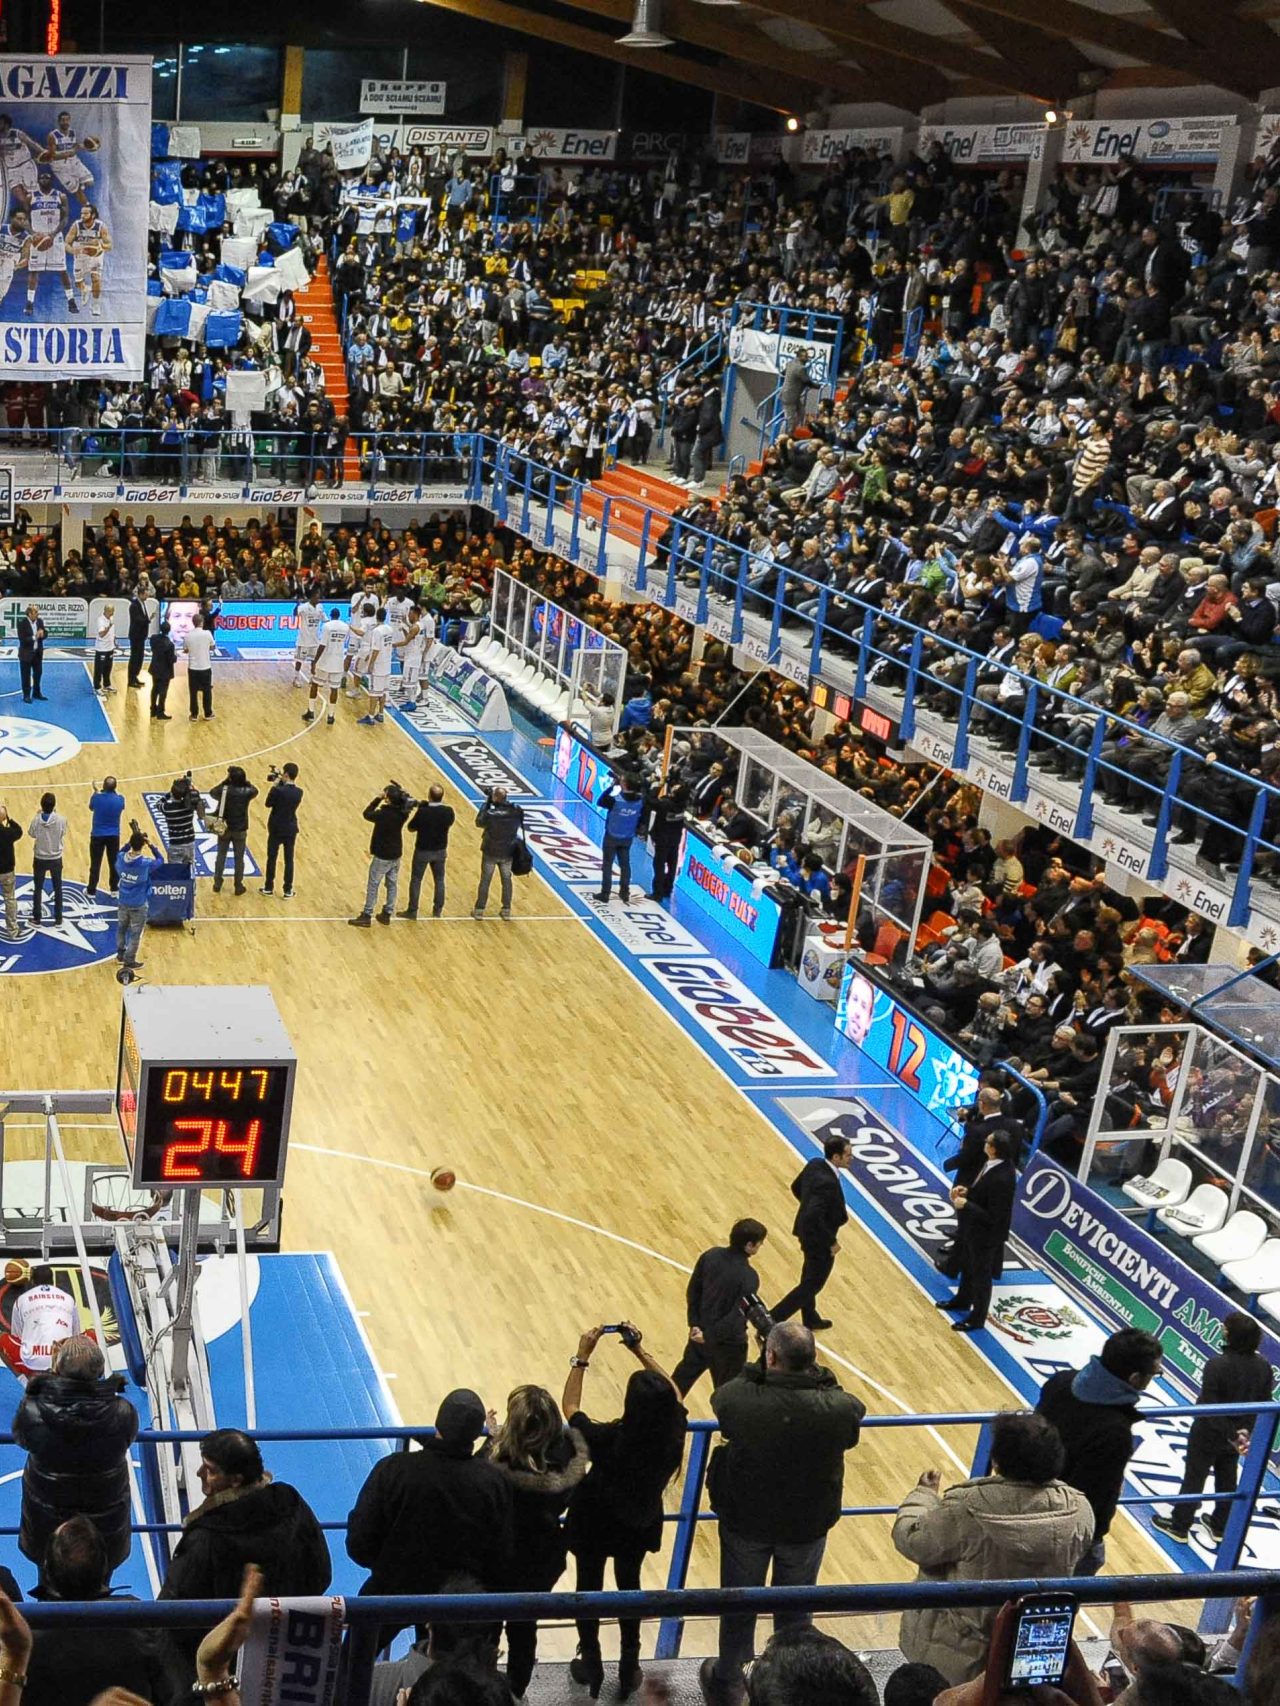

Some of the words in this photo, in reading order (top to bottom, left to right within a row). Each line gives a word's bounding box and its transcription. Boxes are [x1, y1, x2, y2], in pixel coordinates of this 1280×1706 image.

[411, 130, 486, 145] DISTANTE
[561, 133, 612, 156] Enel
[1091, 126, 1141, 157] Enel
[4, 326, 125, 365] STORIA
[214, 615, 276, 630] ROBERT
[932, 743, 953, 764] Enel
[578, 748, 595, 802] 12
[987, 776, 1011, 798] Enel
[1048, 809, 1074, 833] Enel
[1116, 847, 1146, 874] Enel
[687, 854, 727, 906] ROBERT
[1193, 890, 1225, 920] Enel
[623, 911, 693, 947] Enel
[889, 1009, 927, 1092] 12
[162, 1119, 261, 1178] 24
[1021, 1167, 1180, 1310] DEVICIENTI
[1061, 1243, 1108, 1286] BONIFICHE
[1081, 1274, 1134, 1323] AMBIENTALI
[32, 1344, 53, 1357] MIL
